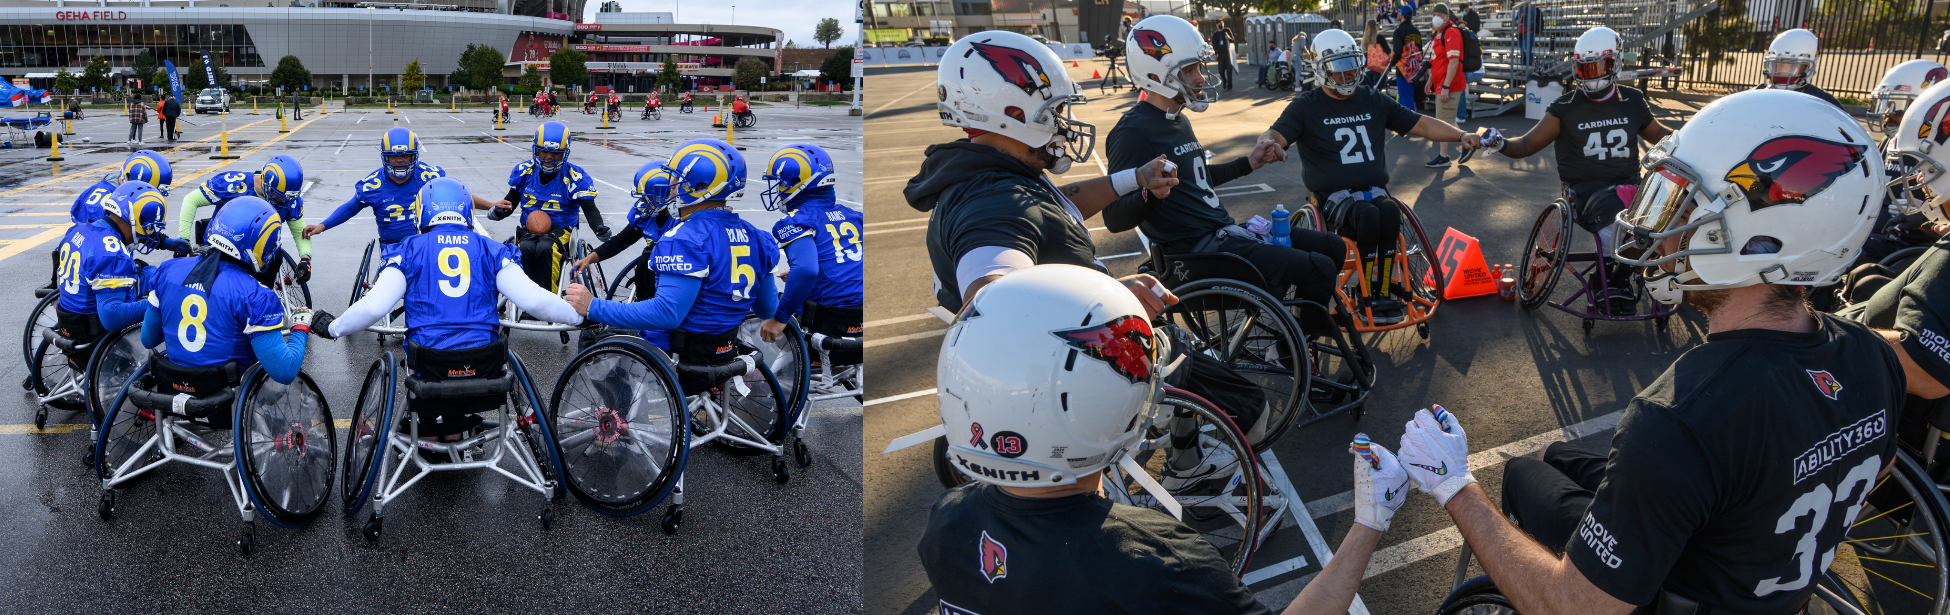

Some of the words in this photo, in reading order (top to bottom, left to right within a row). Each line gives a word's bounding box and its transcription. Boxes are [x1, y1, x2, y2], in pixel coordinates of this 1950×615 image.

[56, 11, 90, 20] GEHA
[93, 11, 126, 20] FIELD
[1323, 113, 1372, 125] CARDINALS
[1578, 117, 1629, 130] CARDINALS
[1334, 125, 1375, 164] 21
[1583, 128, 1630, 161] 42
[224, 173, 248, 193] 33
[1193, 156, 1220, 209] 9
[825, 210, 846, 221] RAMS
[438, 234, 469, 245] RAMS
[725, 228, 749, 243] RAMS
[777, 224, 796, 235] MOVE
[211, 236, 234, 253] XENITH
[825, 222, 863, 263] 13
[655, 255, 684, 263] MOVE
[656, 263, 692, 271] UNITED
[1430, 235, 1468, 288] 15
[438, 247, 471, 298] 9
[730, 245, 756, 301] 5
[178, 294, 208, 352] 8
[1919, 336, 1950, 364] UNITE
[1922, 328, 1950, 349] MOV
[996, 436, 1021, 454] 13
[1797, 417, 1885, 478] ABILITY360
[956, 454, 1040, 481] XENITH
[1585, 511, 1618, 552] MOVE
[1580, 523, 1622, 569] UNITED
